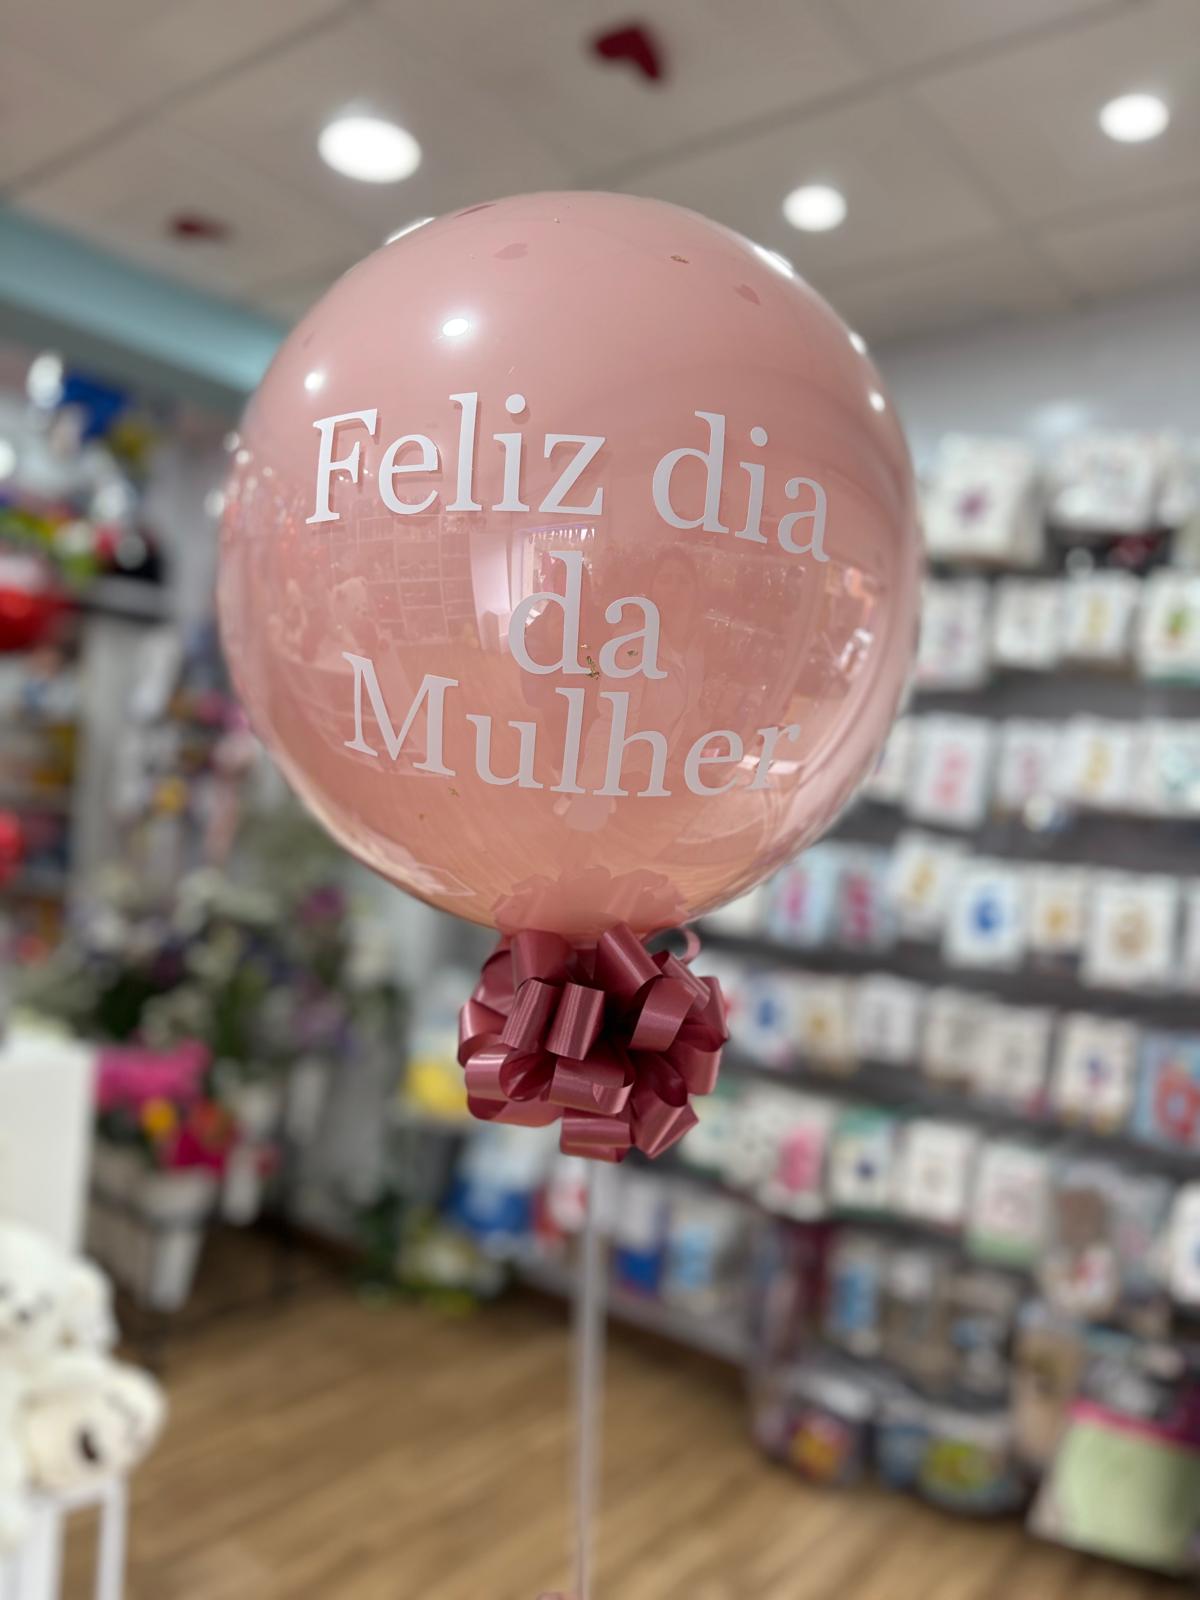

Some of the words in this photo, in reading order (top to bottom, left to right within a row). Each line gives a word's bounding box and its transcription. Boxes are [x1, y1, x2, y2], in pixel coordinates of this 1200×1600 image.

[305, 392, 606, 524] Feliz
[652, 410, 831, 562] dia
[508, 550, 668, 680] da
[342, 652, 800, 798] Mulher
